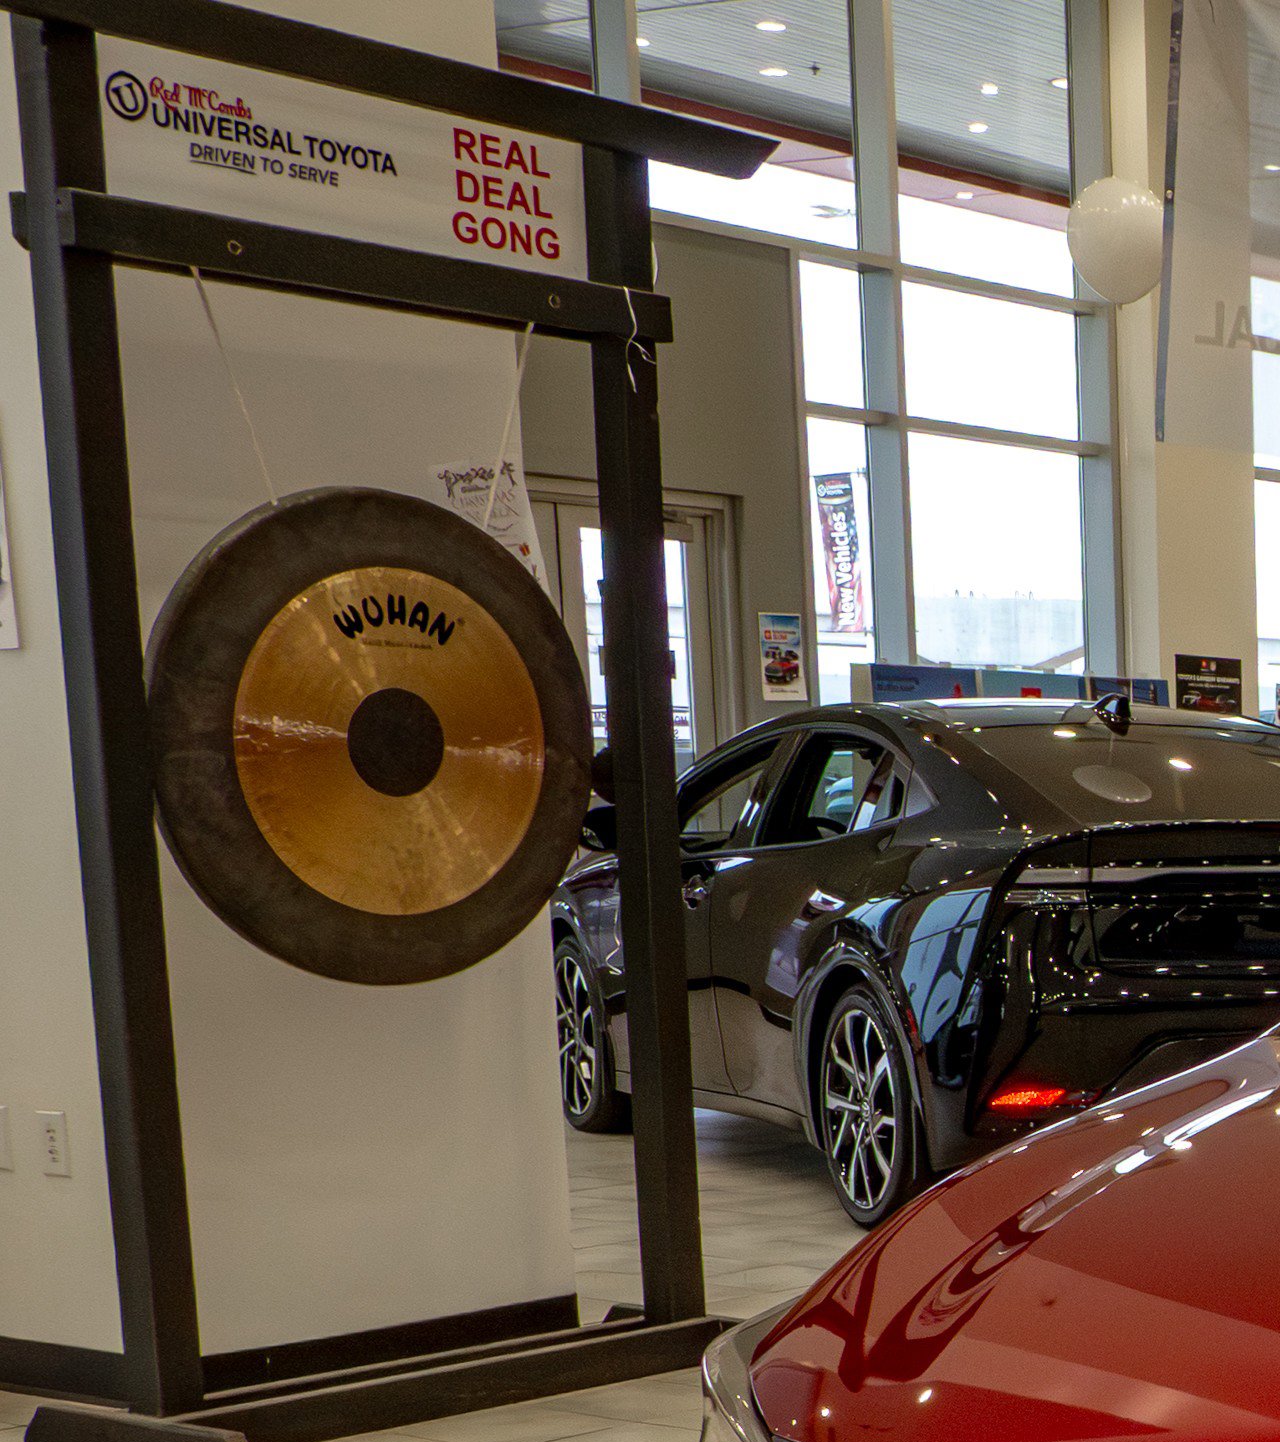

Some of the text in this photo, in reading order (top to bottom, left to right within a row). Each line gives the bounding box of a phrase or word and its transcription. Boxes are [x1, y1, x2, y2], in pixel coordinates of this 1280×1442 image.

[150, 76, 253, 120] Red McCombs
[152, 103, 398, 177] UNIVERSAL TOYOTA
[190, 143, 339, 187] DRIVEN TO SERVE
[453, 127, 551, 179] REAL
[456, 169, 554, 219] DEAL
[452, 211, 560, 260] GONG
[831, 511, 856, 627] New Vehicles
[333, 592, 455, 646] WUHAN
